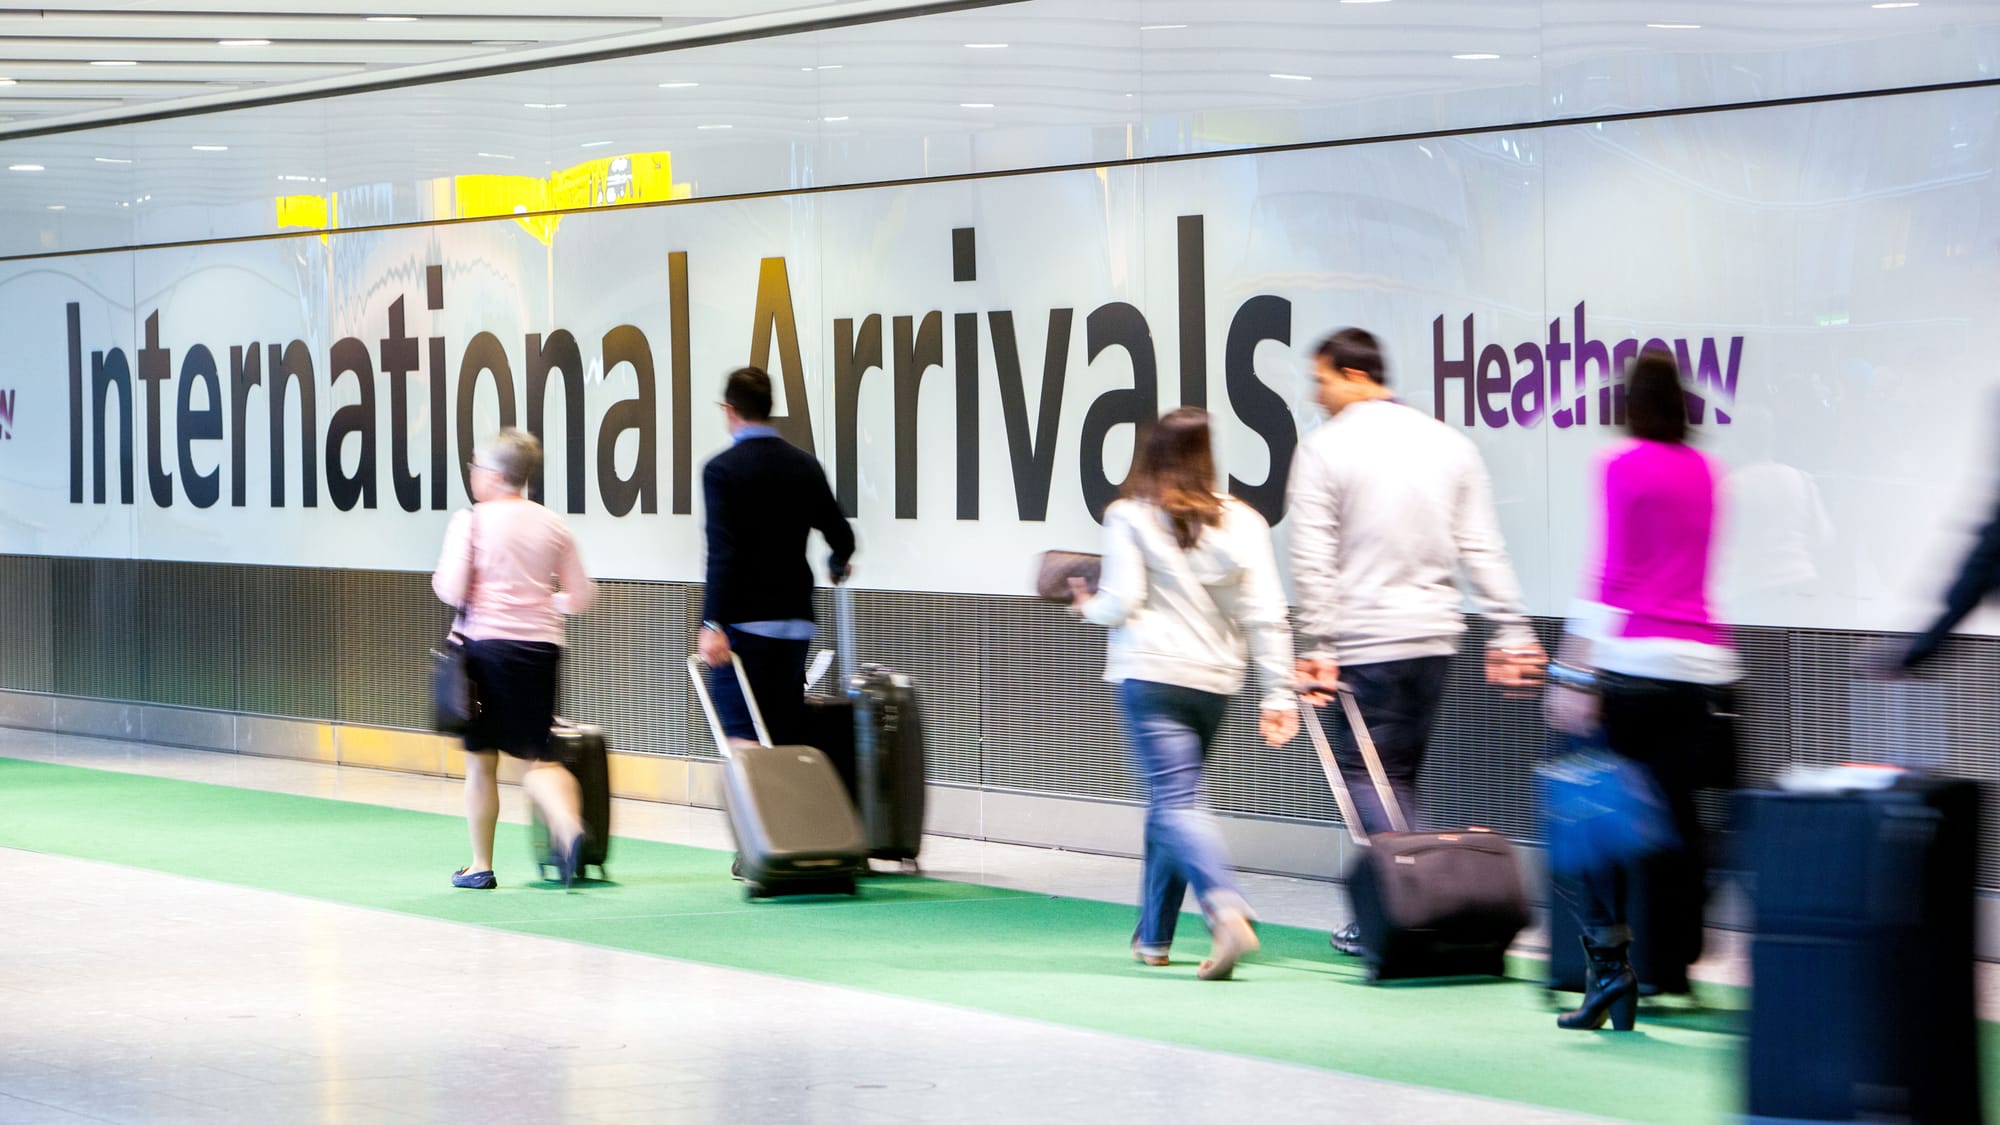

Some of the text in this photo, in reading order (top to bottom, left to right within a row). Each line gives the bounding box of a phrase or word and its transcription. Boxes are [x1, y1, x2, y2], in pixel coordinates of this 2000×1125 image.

[66, 214, 1298, 528] International Arrivals
[1433, 300, 1744, 428] Heathrw
